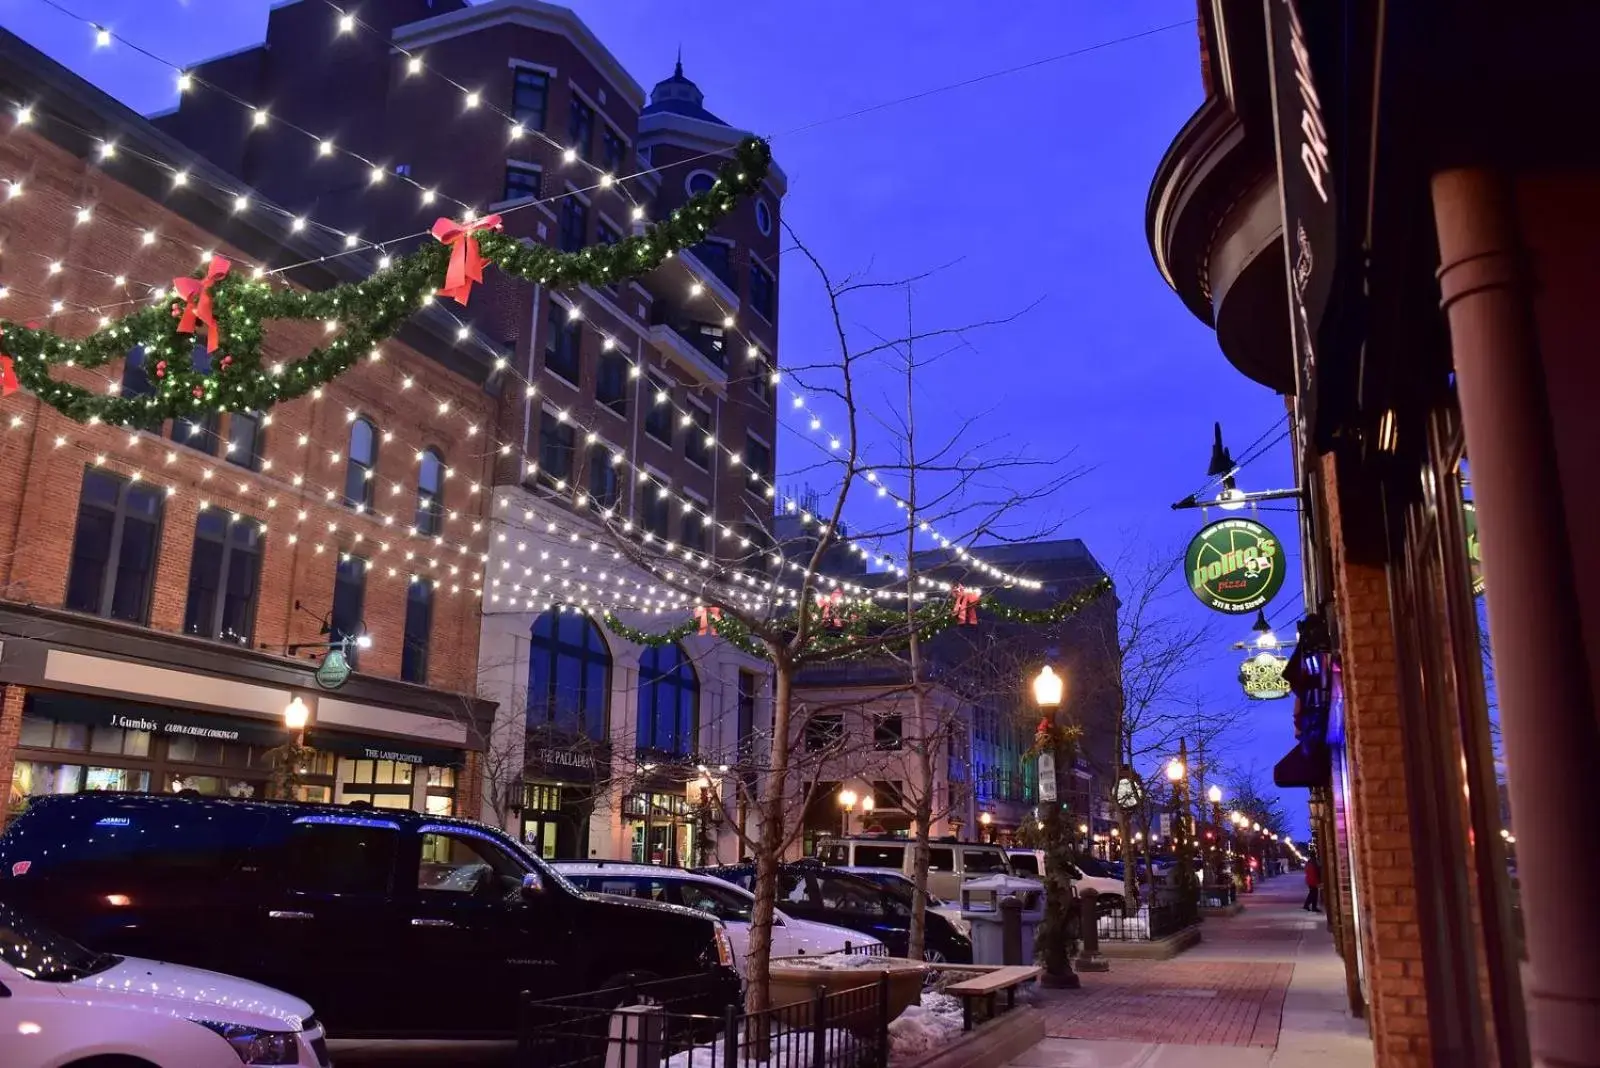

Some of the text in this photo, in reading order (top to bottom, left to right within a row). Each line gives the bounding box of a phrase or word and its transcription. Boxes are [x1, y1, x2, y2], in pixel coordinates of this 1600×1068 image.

[1193, 538, 1276, 588] polito's
[1217, 580, 1247, 592] pizza
[1244, 595, 1266, 610] Street
[1246, 680, 1290, 691] BEYOND
[110, 714, 118, 727] J.
[119, 716, 158, 731] Gumbo's
[364, 748, 423, 763] THE LAMPLIGHTER
